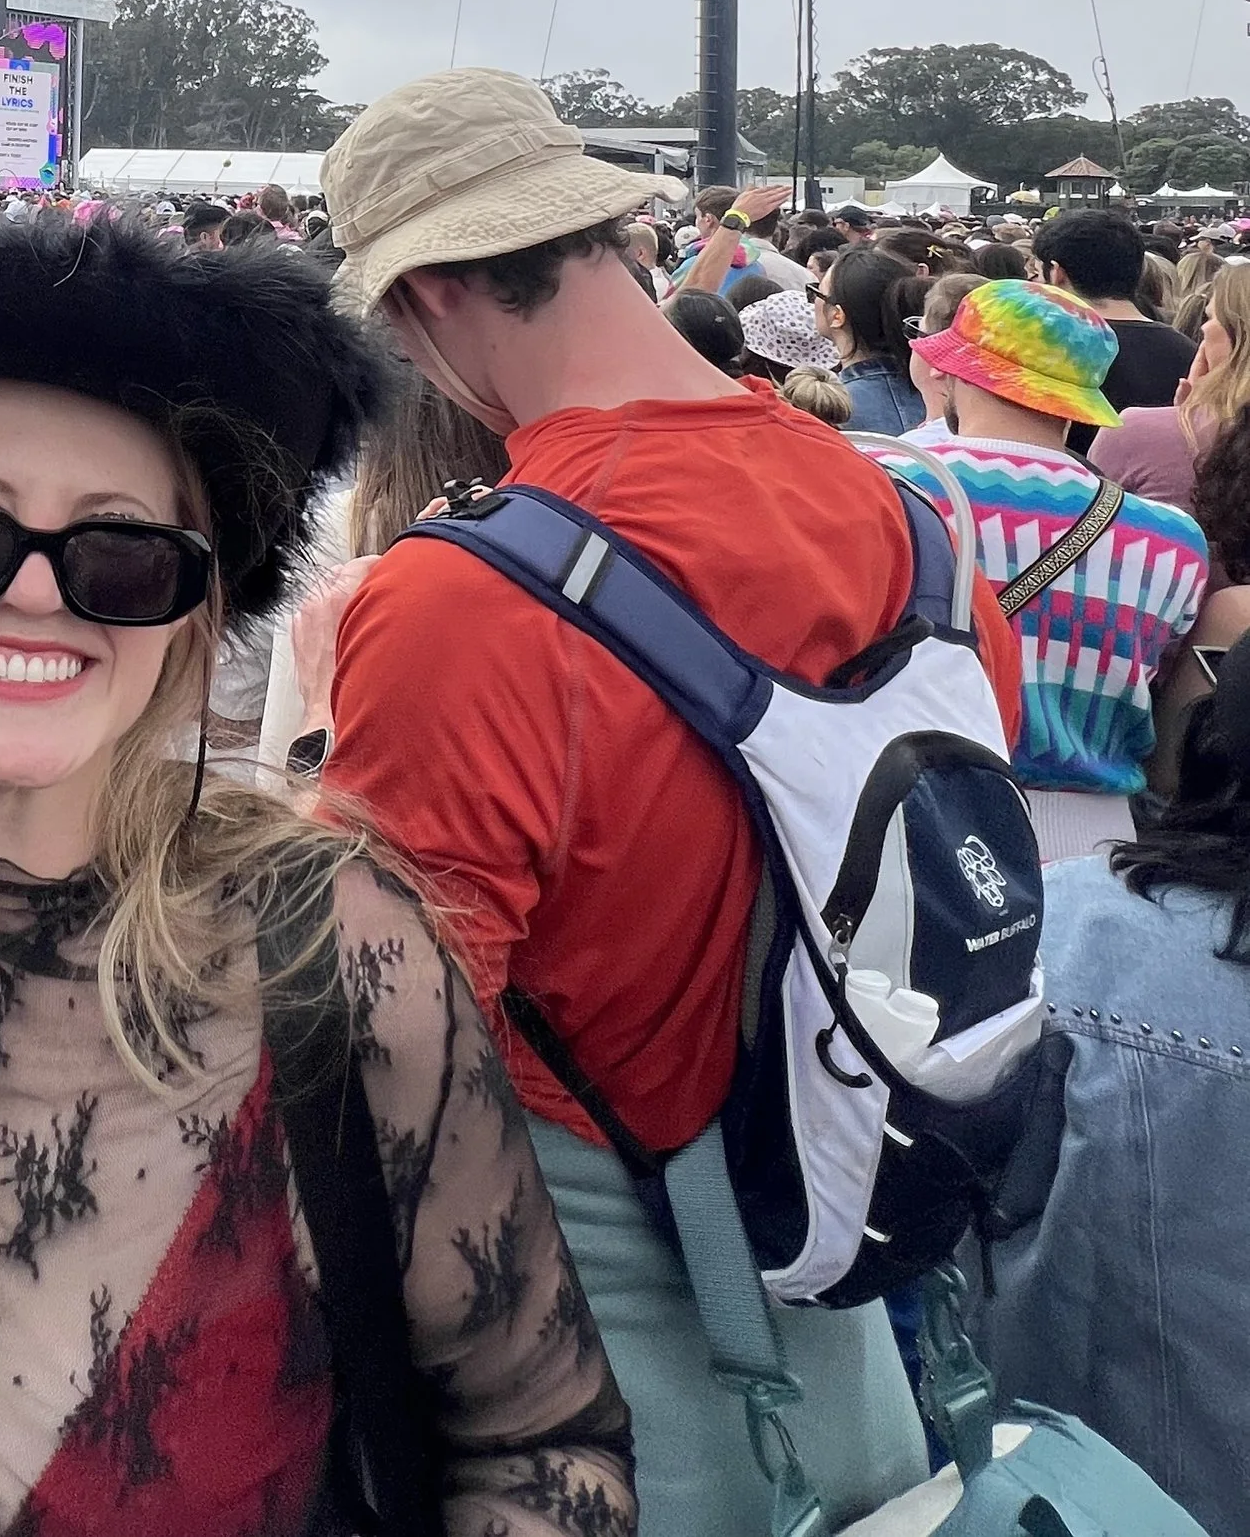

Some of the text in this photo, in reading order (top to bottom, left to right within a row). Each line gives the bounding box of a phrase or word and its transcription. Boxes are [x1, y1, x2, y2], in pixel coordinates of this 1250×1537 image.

[3, 73, 33, 84] FINISH
[9, 86, 27, 95] THE
[1, 97, 33, 108] LYRICS
